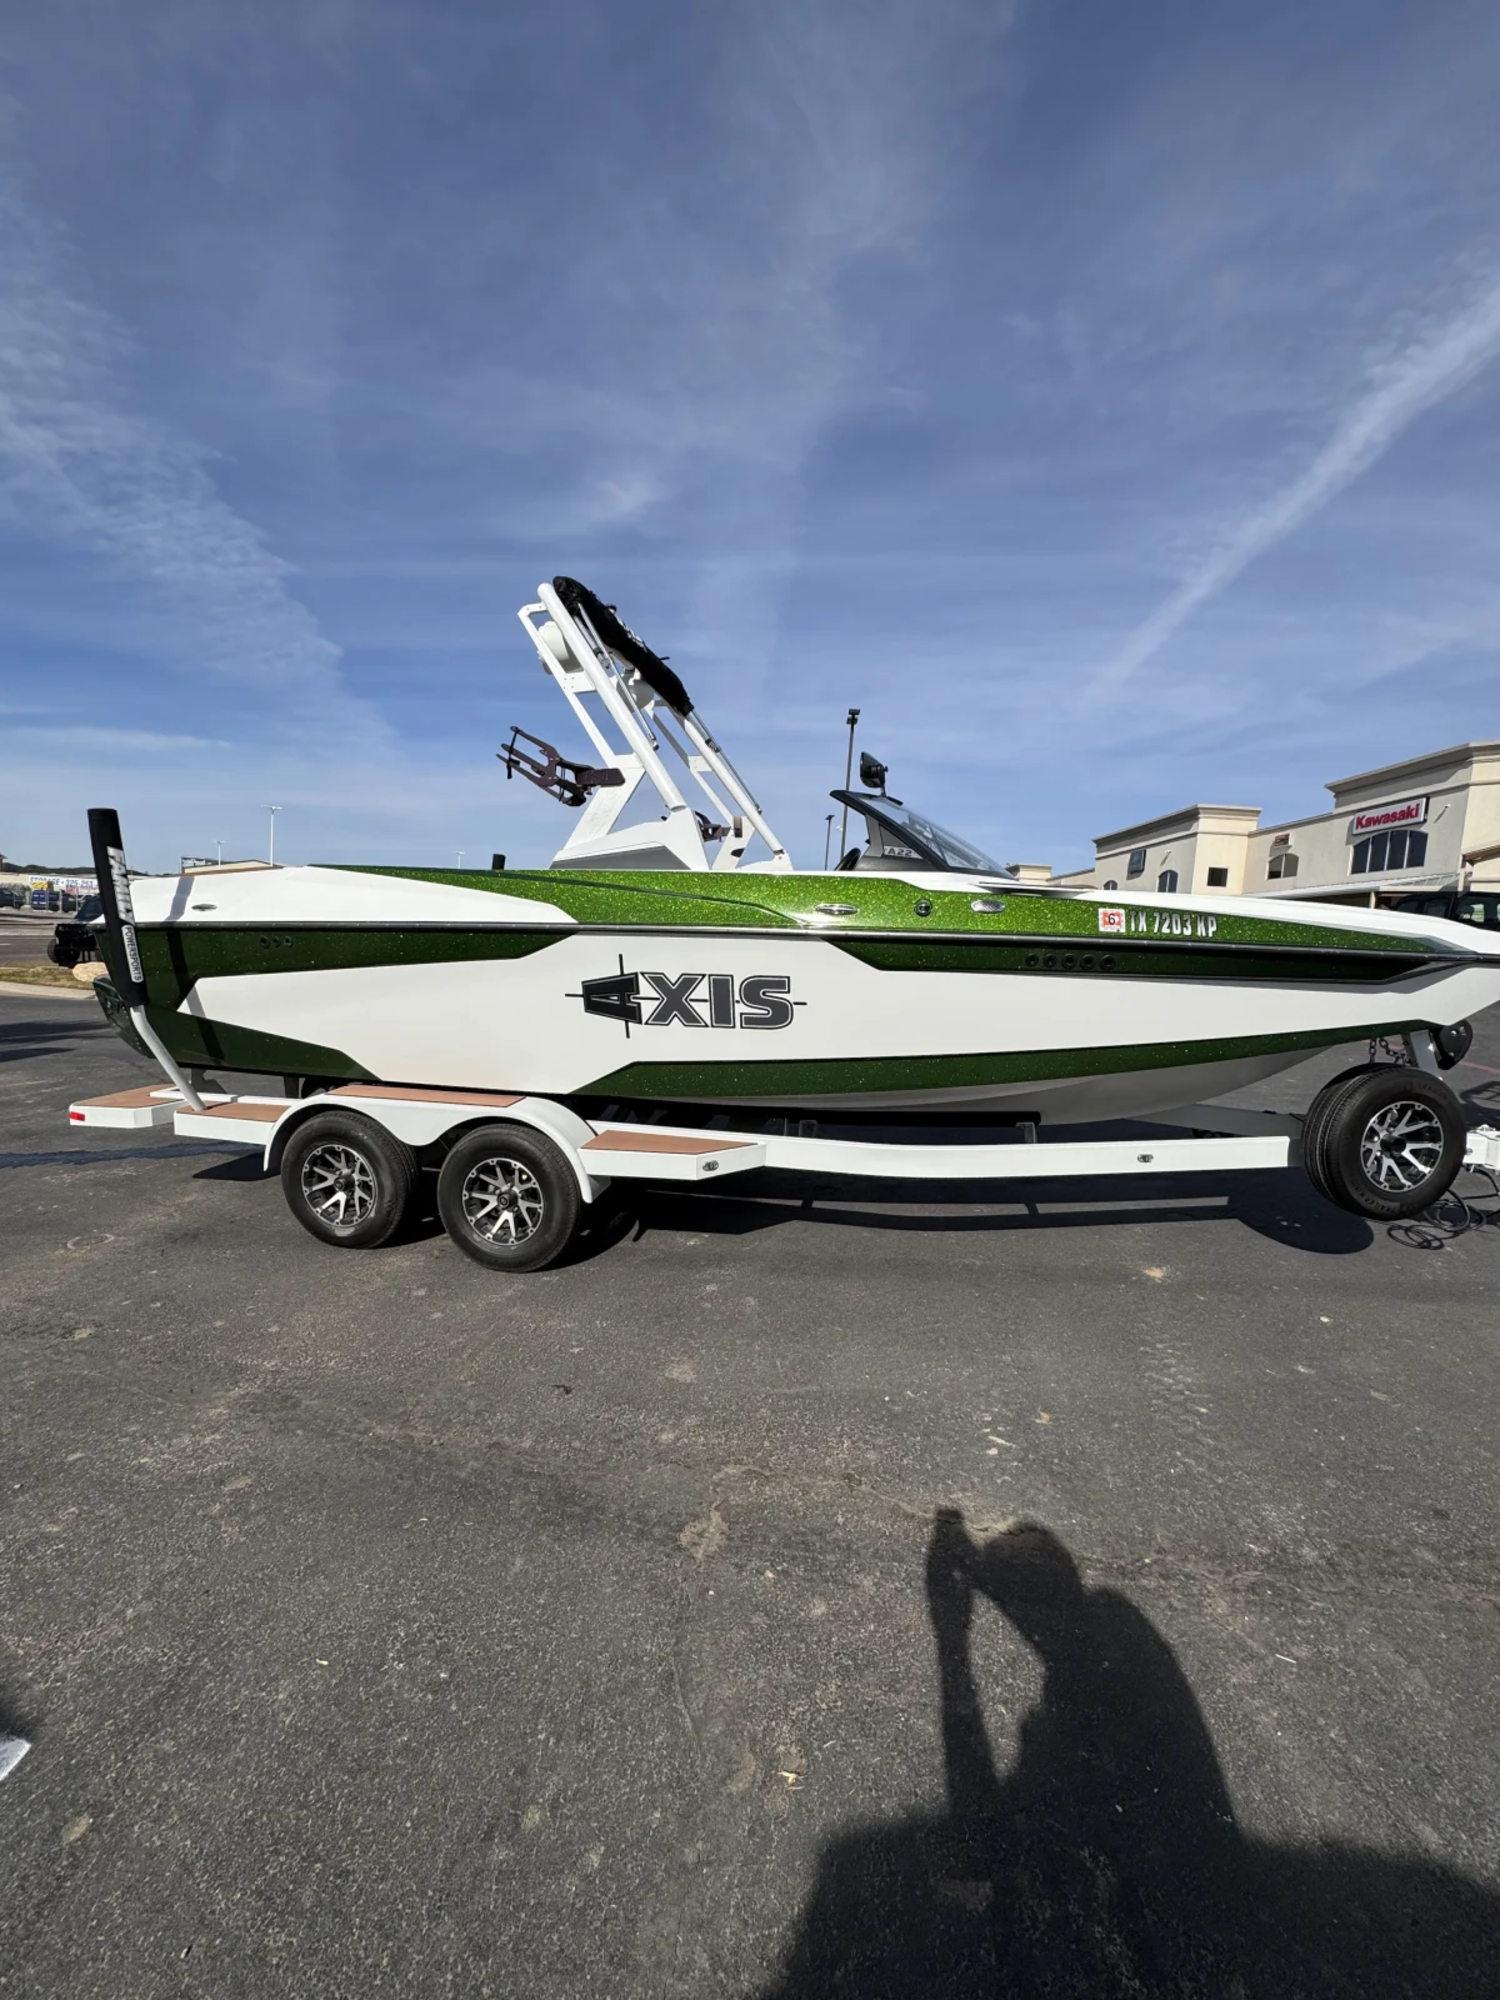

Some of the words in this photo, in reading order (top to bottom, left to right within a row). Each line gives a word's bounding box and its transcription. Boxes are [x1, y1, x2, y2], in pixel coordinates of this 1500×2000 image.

[1355, 803, 1420, 830] Kawasaki
[106, 846, 136, 926] FAMILY
[1108, 913, 1116, 925] 6
[1130, 911, 1147, 932] TX
[1153, 912, 1192, 936] 7203
[1197, 915, 1217, 937] KP
[124, 926, 142, 981] POWERSPORTS
[581, 972, 794, 1030] AXIS
